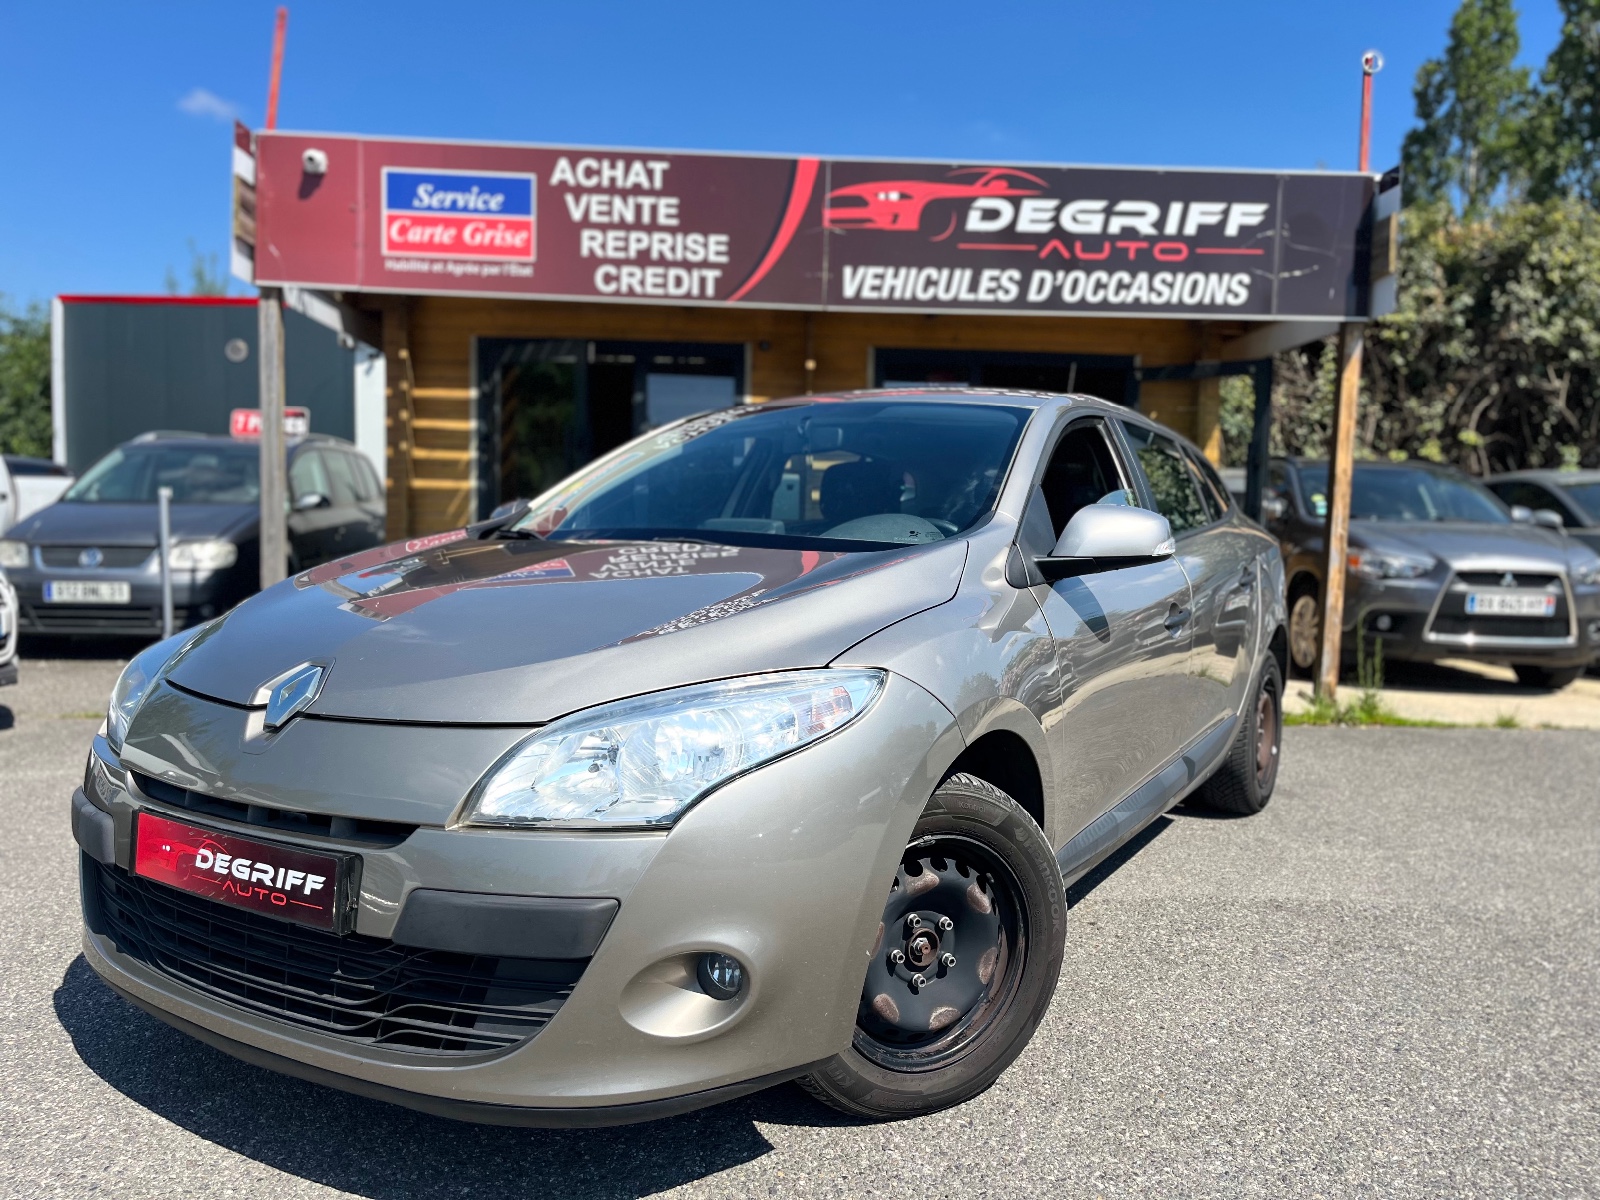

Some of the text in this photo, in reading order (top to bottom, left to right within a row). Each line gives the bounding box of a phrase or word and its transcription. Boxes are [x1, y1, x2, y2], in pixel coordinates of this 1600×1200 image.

[550, 157, 671, 191] ACHAT
[412, 182, 506, 212] Service
[564, 193, 680, 226] VENTE
[389, 217, 529, 249] Carte Grise
[964, 197, 1270, 238] DEGRIFF
[580, 228, 730, 264] REPRISE
[1039, 238, 1190, 262] AUTO
[594, 264, 723, 298] CREDIT
[840, 265, 1252, 307] VEHICULES D'OCCASIONS
[195, 849, 327, 896] DEGRIFF
[222, 880, 288, 907] AUTO
